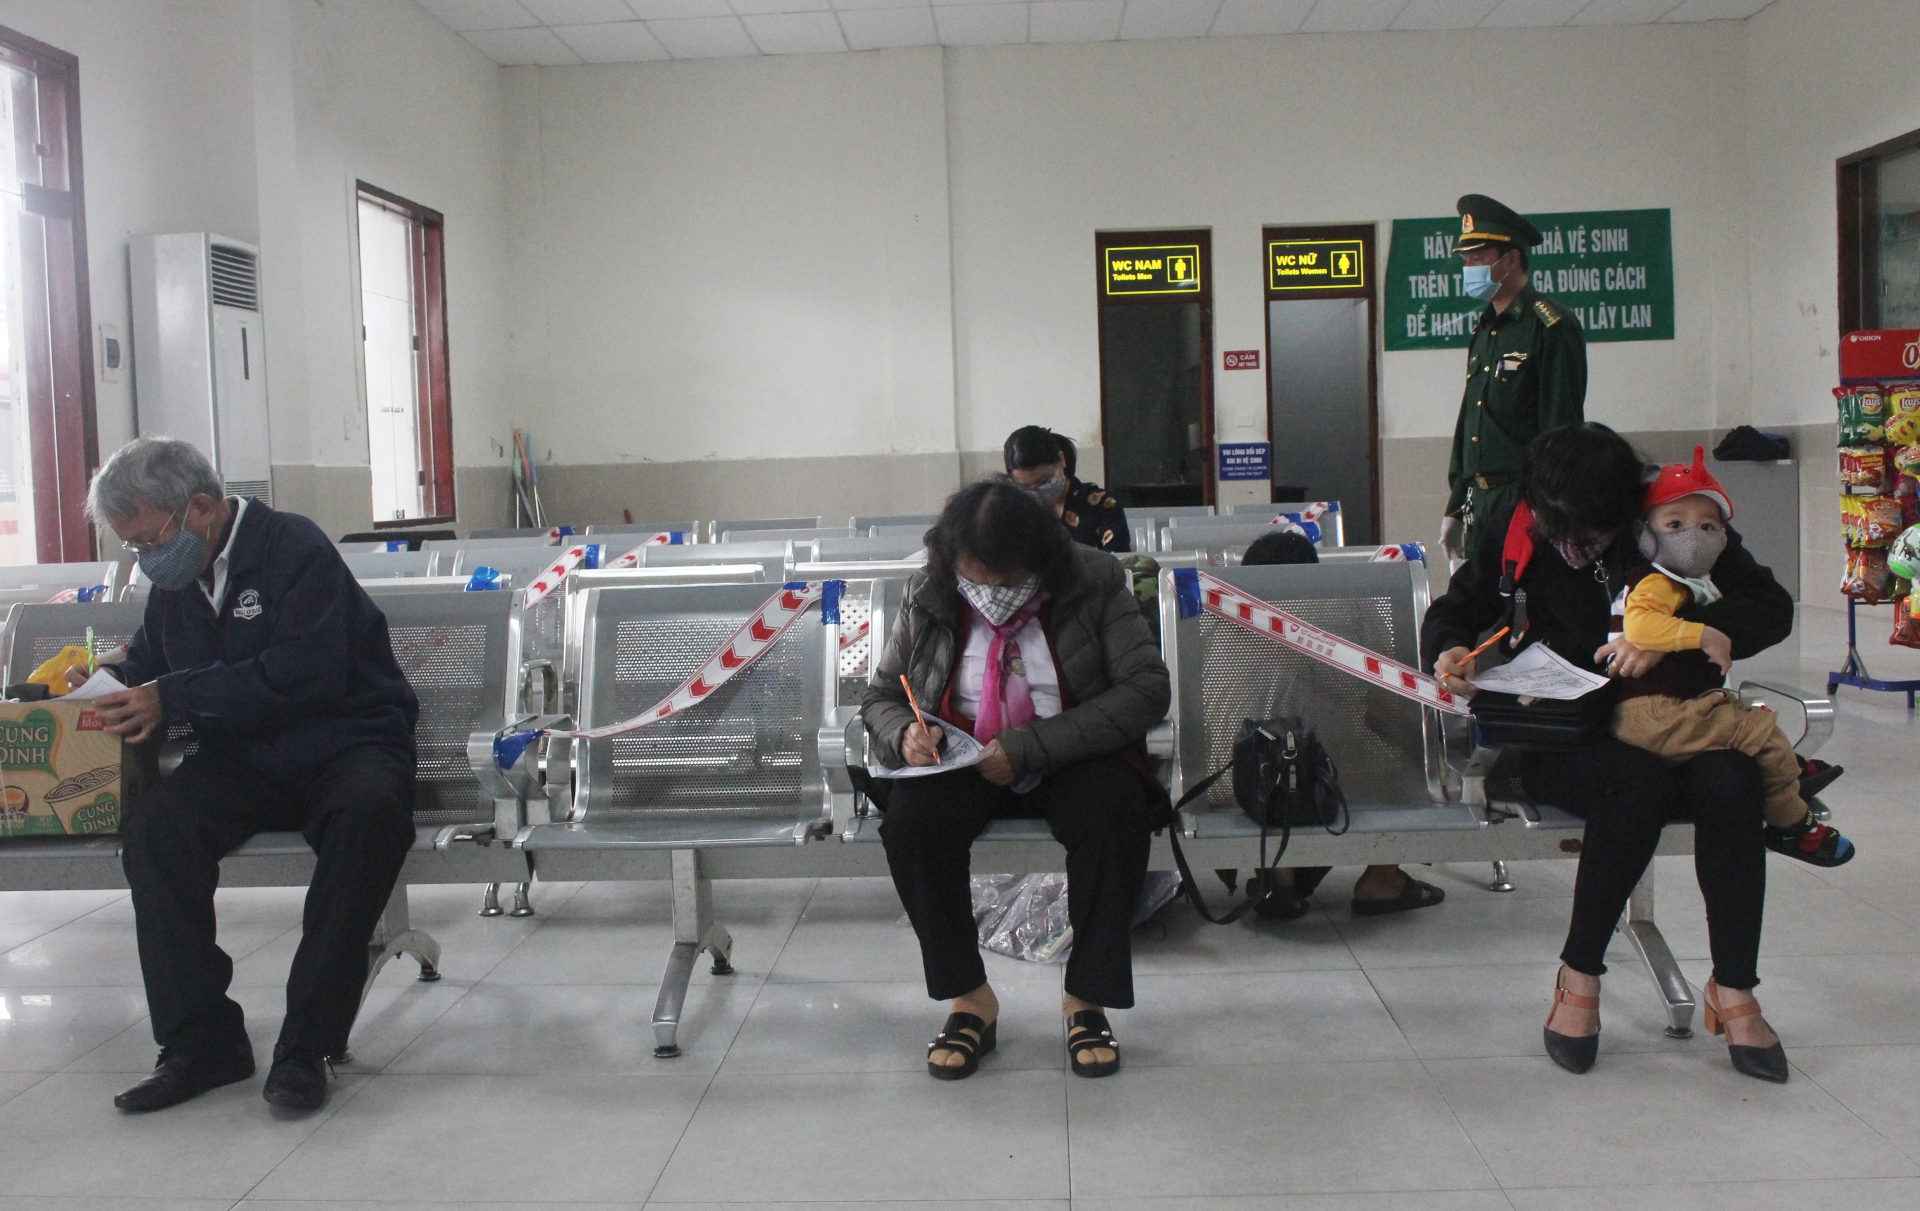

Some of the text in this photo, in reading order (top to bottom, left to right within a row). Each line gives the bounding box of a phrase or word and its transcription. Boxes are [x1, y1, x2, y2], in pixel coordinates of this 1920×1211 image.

[1423, 231, 1454, 259] HÃY
[1567, 225, 1586, 258] VỆ
[1591, 229, 1628, 252] SINH
[1112, 259, 1162, 271] WC NAM
[1276, 252, 1318, 266] WC NỮ
[1112, 273, 1136, 281] Toilets
[1276, 268, 1300, 276] Toilets
[1409, 270, 1449, 298] TRÊN
[1533, 270, 1554, 293] GA
[1558, 264, 1600, 292] ĐÚNG
[1605, 262, 1646, 290] CÁCH
[1407, 304, 1427, 337] ĐỂ
[1431, 312, 1463, 341] HẠN
[1589, 301, 1617, 330] LÂY
[1622, 304, 1652, 328] LAN
[77, 801, 115, 821] CUNG
